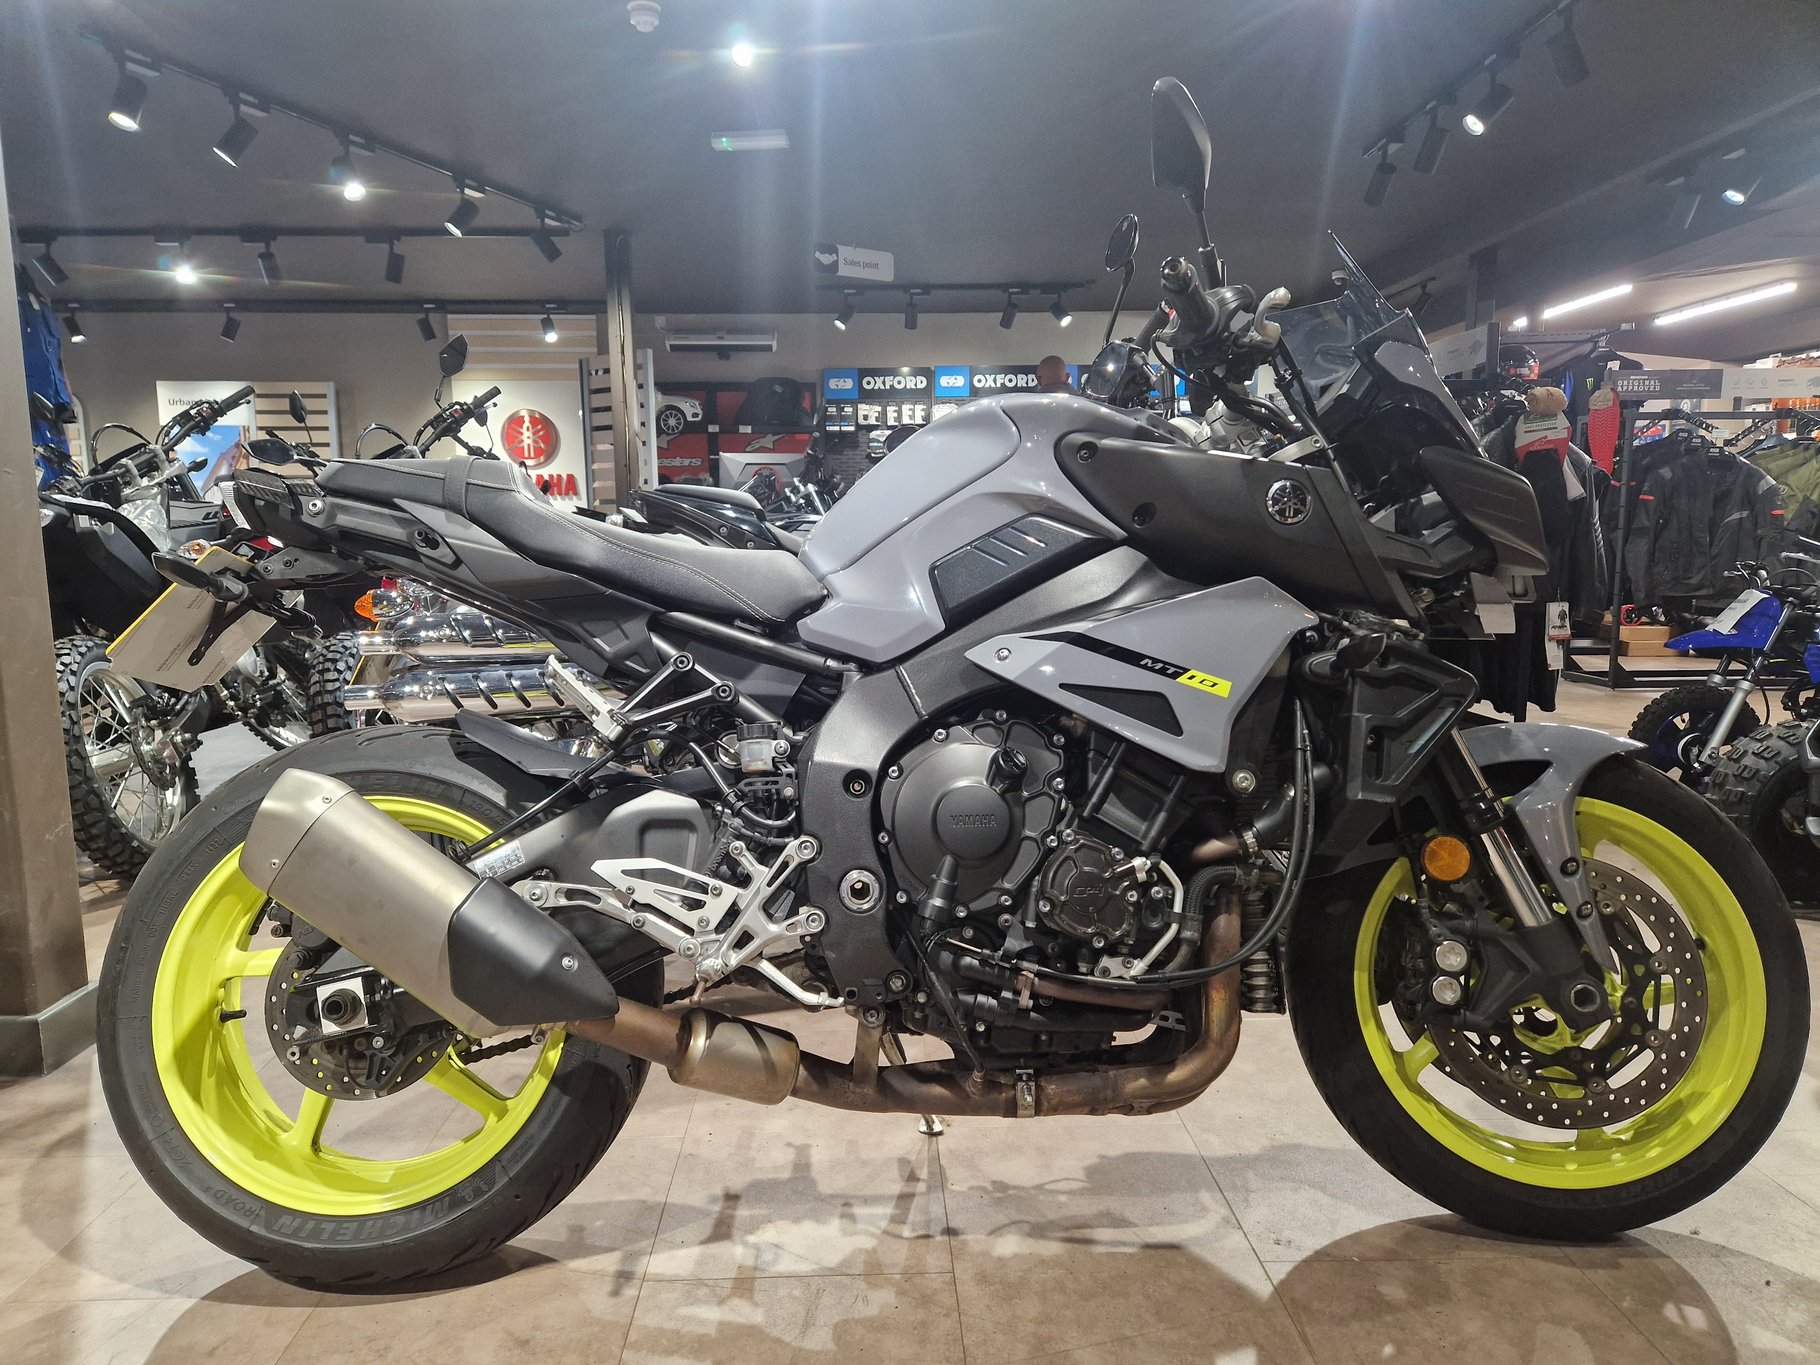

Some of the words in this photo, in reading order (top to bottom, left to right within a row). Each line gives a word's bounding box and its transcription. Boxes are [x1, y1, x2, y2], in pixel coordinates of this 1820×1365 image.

[843, 257, 861, 268] Sales
[863, 260, 880, 270] point
[862, 375, 928, 390] OXFORD
[973, 373, 1038, 388] OXFORD
[1140, 658, 1184, 675] MT
[950, 814, 997, 828] YAMAHA
[272, 1196, 450, 1242] MICHELIN
